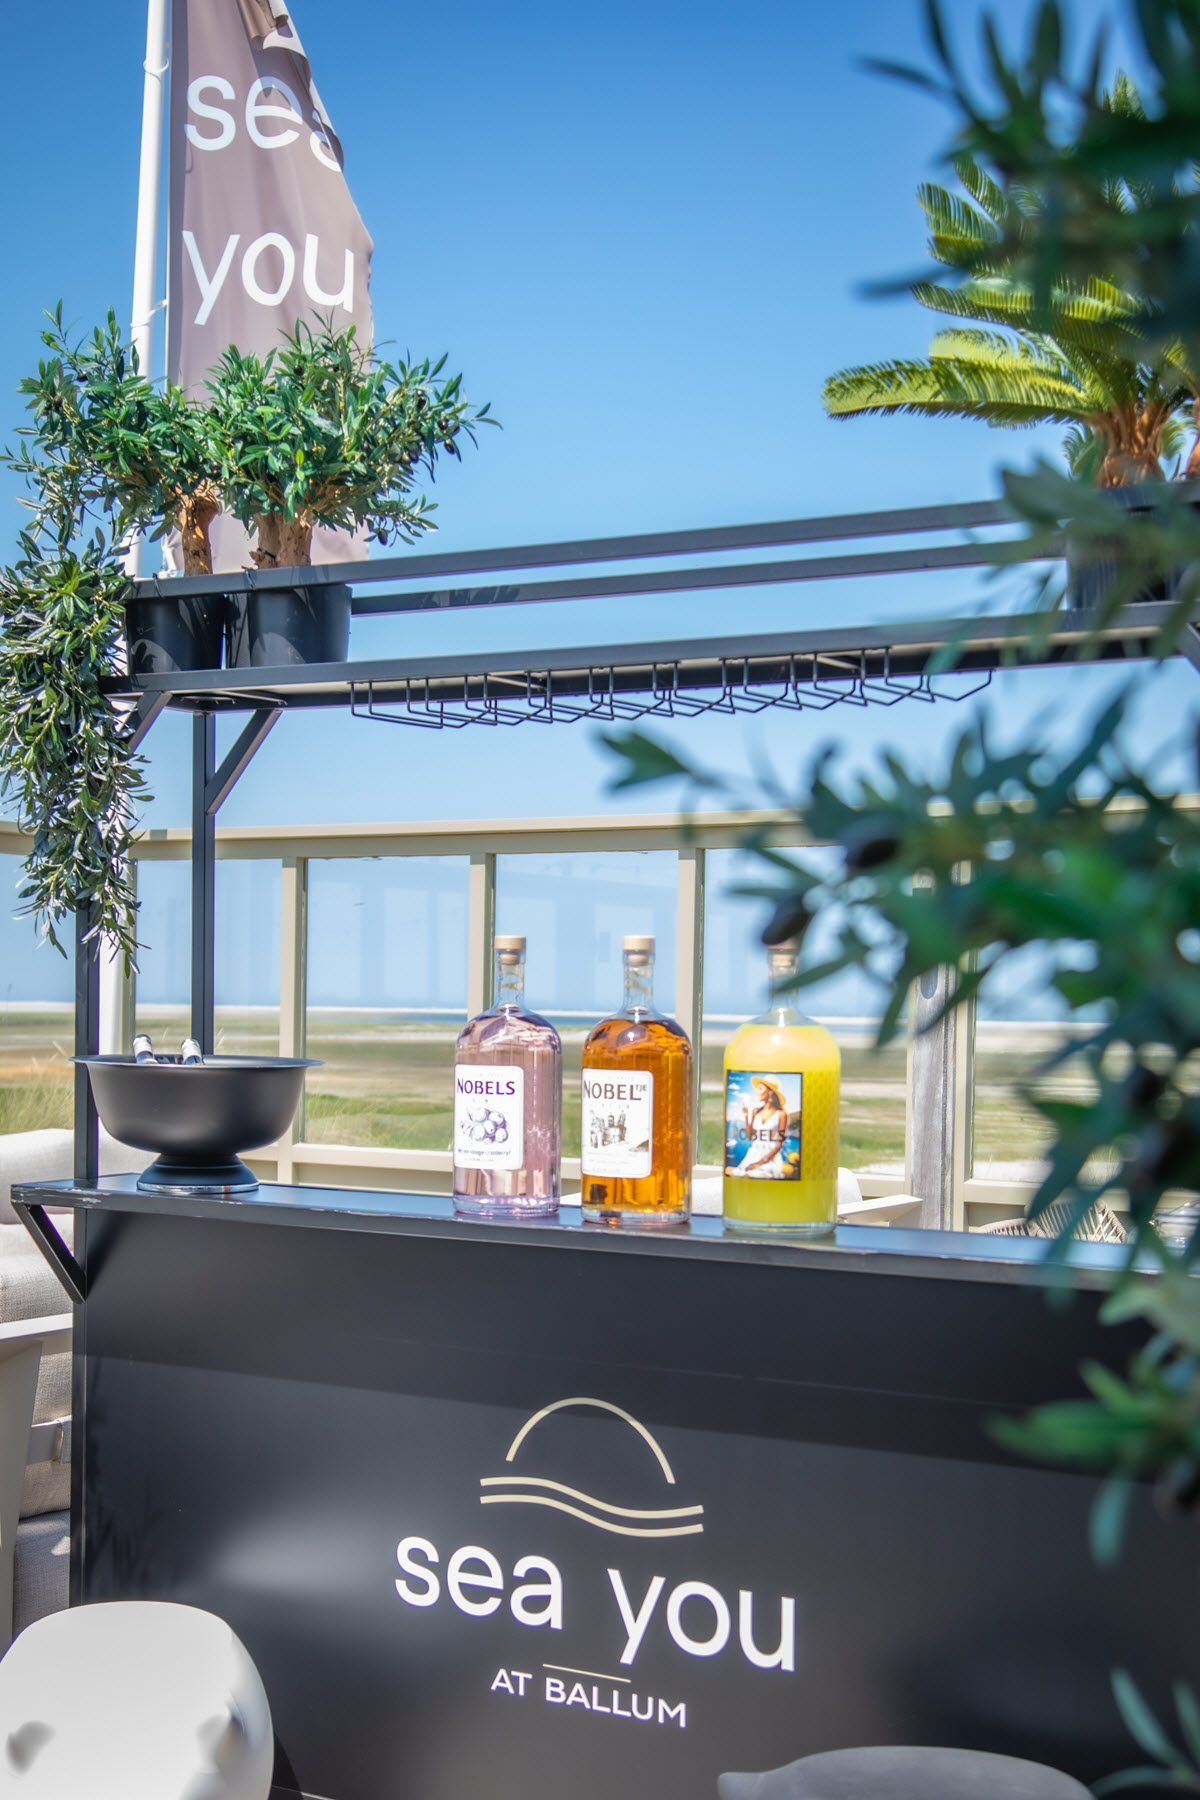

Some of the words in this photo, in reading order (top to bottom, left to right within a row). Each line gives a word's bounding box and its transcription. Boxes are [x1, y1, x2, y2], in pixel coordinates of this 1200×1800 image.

[182, 230, 354, 325] you
[457, 1078, 516, 1096] NOBELS
[394, 1535, 564, 1631] sea
[607, 1567, 796, 1673] you
[490, 1668, 533, 1697] AT
[545, 1677, 687, 1729] BALLUM
